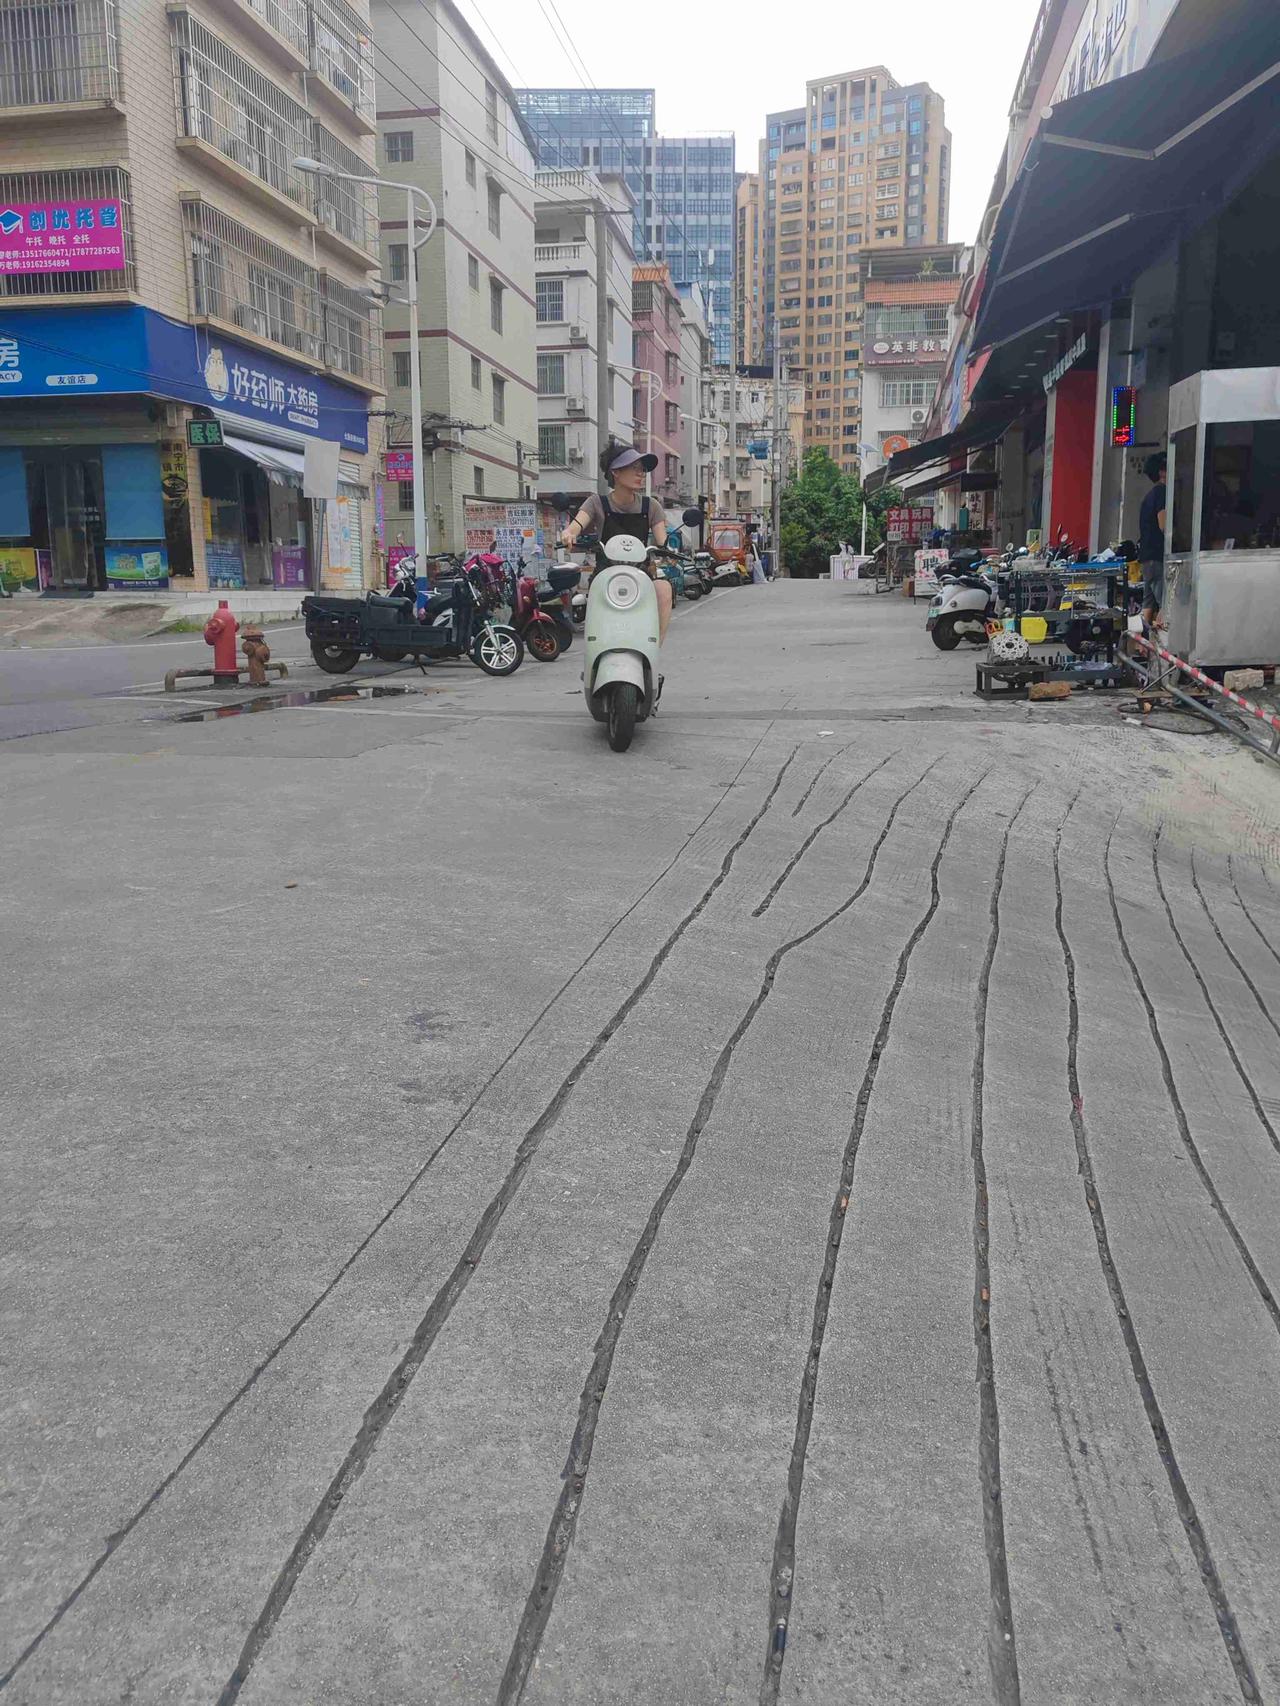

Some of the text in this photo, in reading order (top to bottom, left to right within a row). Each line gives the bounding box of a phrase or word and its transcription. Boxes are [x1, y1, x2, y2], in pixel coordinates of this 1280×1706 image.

[29, 206, 118, 232] 创优托管
[25, 234, 90, 246] 午托 晚托 全托
[57, 375, 86, 385] 友谊店
[190, 423, 222, 444] 医保
[889, 508, 932, 520] 文具 玩具
